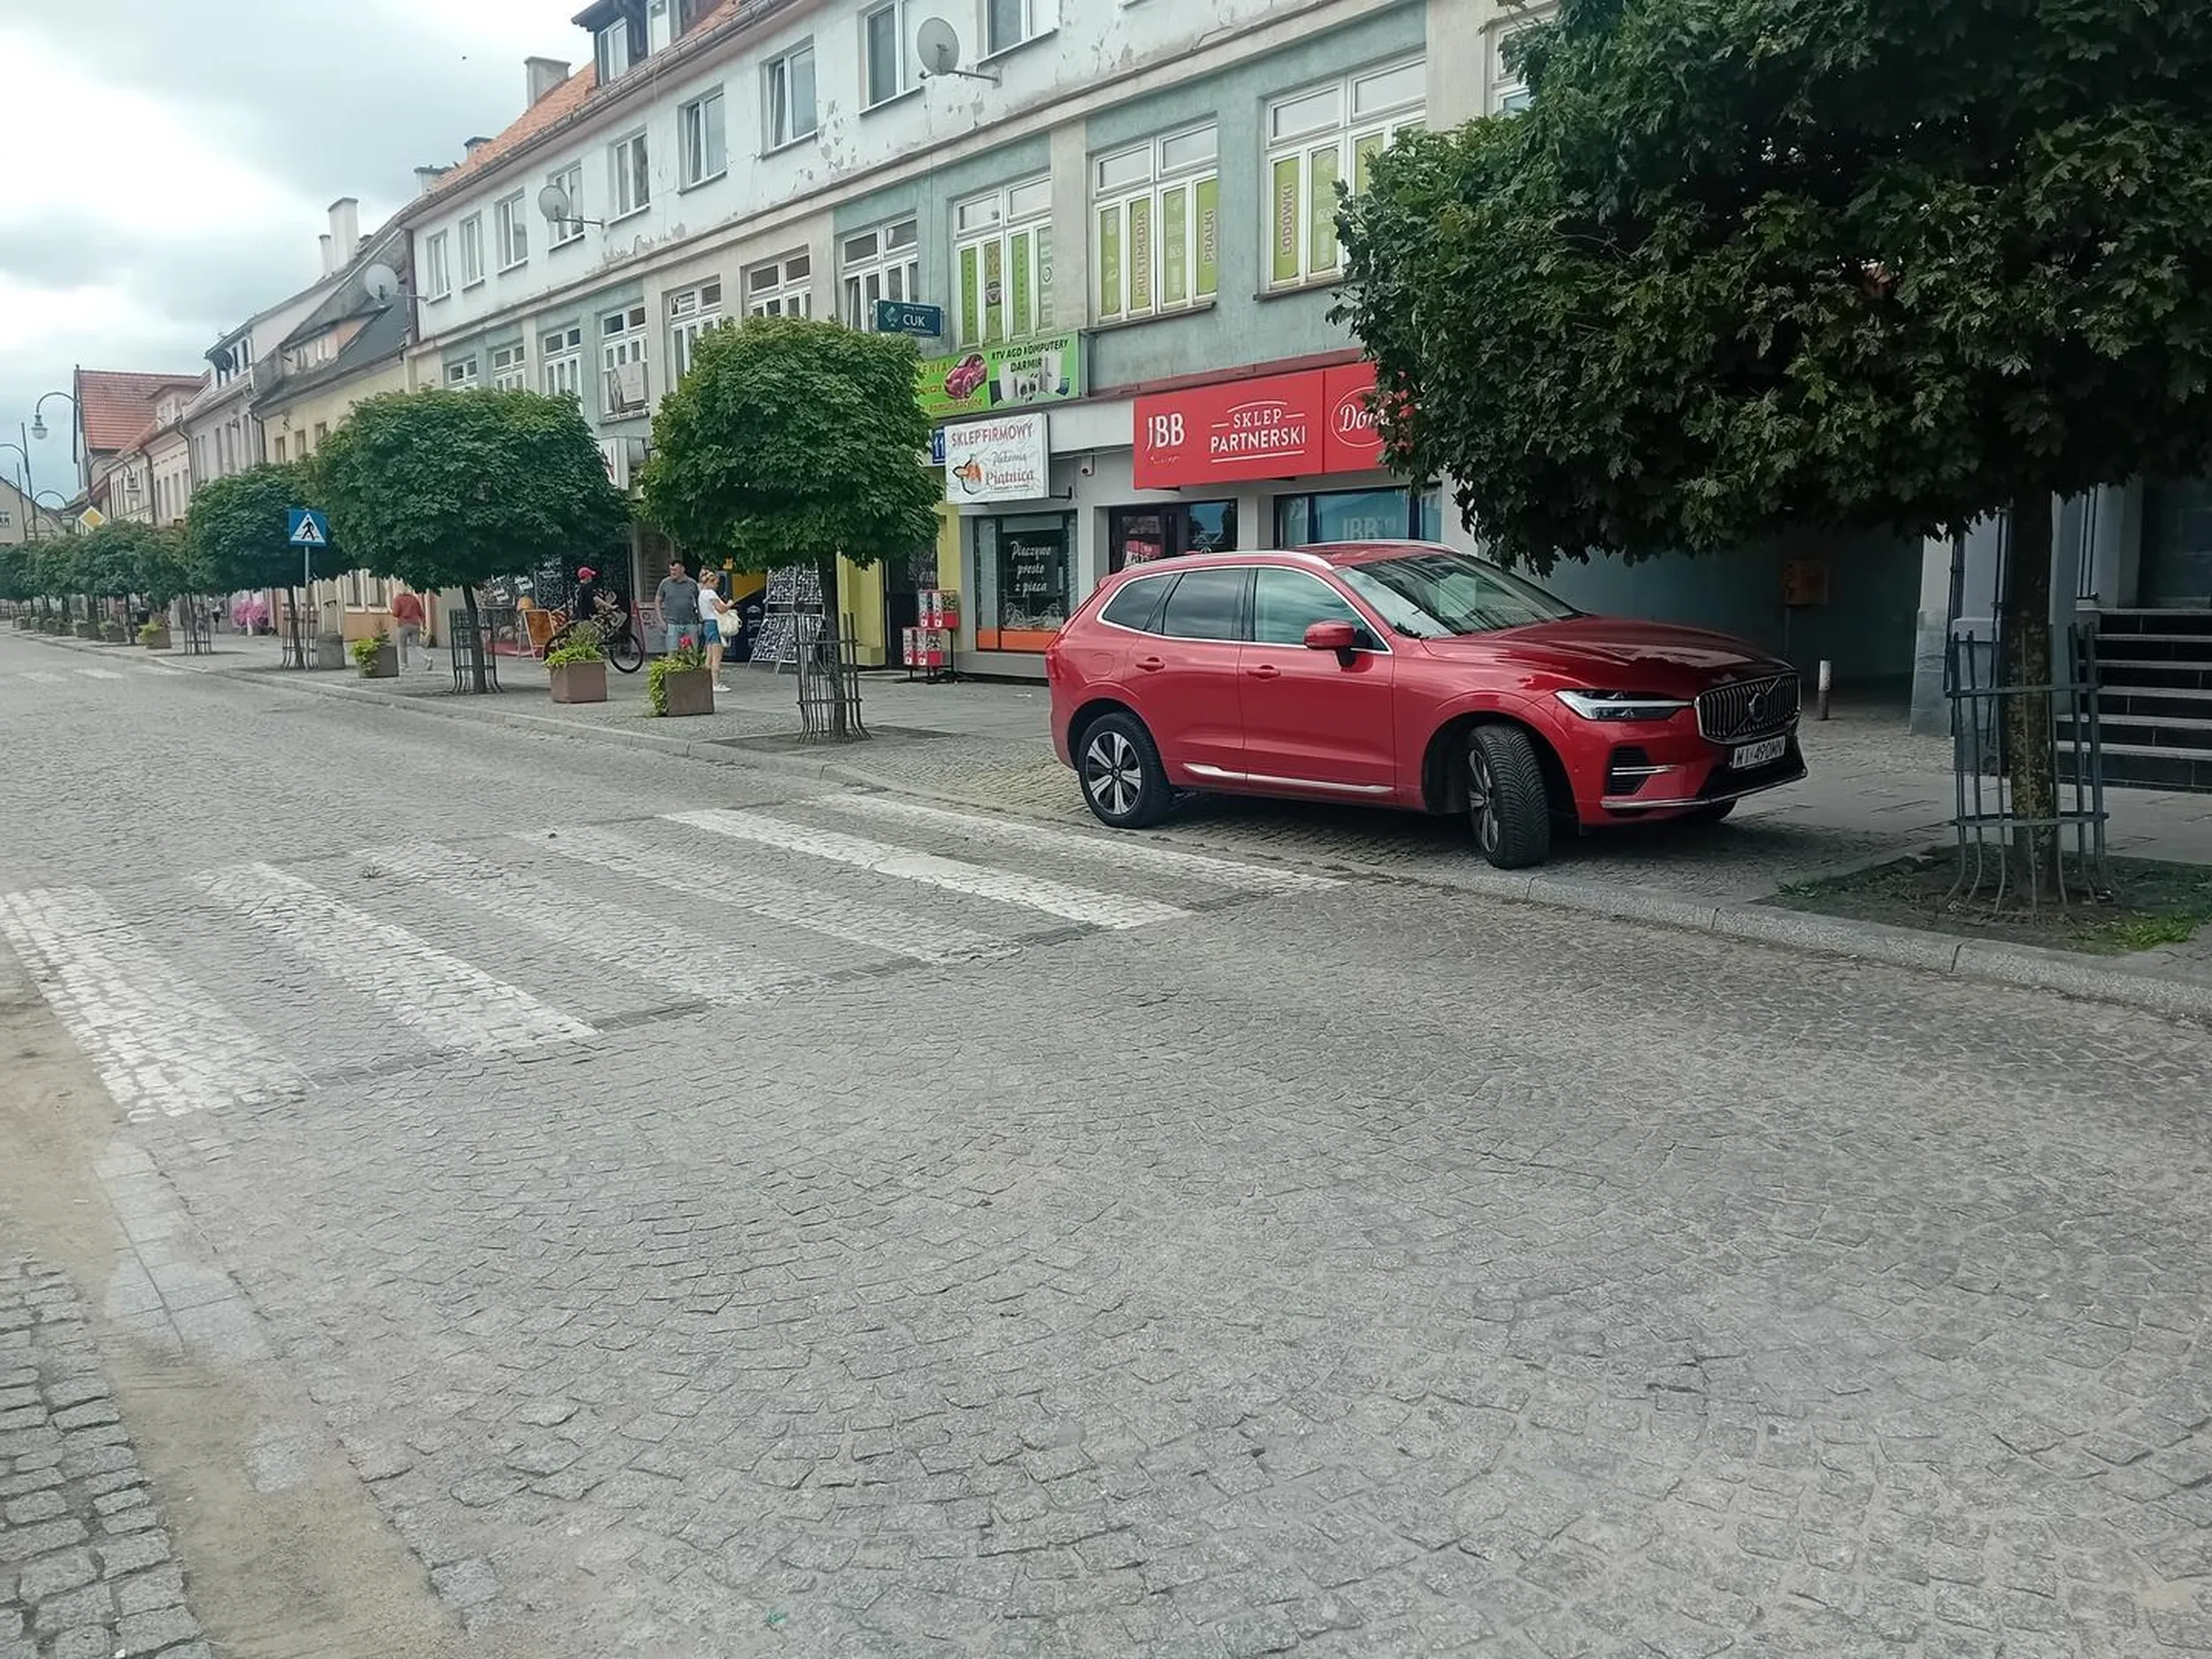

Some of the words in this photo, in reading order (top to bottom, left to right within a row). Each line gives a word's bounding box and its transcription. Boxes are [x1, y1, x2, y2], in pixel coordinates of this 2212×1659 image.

[1203, 208, 1217, 264] PRALKI
[1136, 208, 1148, 298] MULTIMEDIA
[902, 313, 926, 327] CUK
[991, 349, 1005, 360] RTV
[1006, 346, 1022, 357] AGD
[1023, 338, 1070, 355] KOMPUTERY
[1010, 357, 1042, 373] DARMIR
[1233, 408, 1282, 429] SKLEP
[951, 430, 981, 447] SKLEP
[982, 423, 1033, 442] FIRMOWY
[1145, 412, 1186, 452] JBB
[1210, 426, 1306, 454] PARTNERSKI
